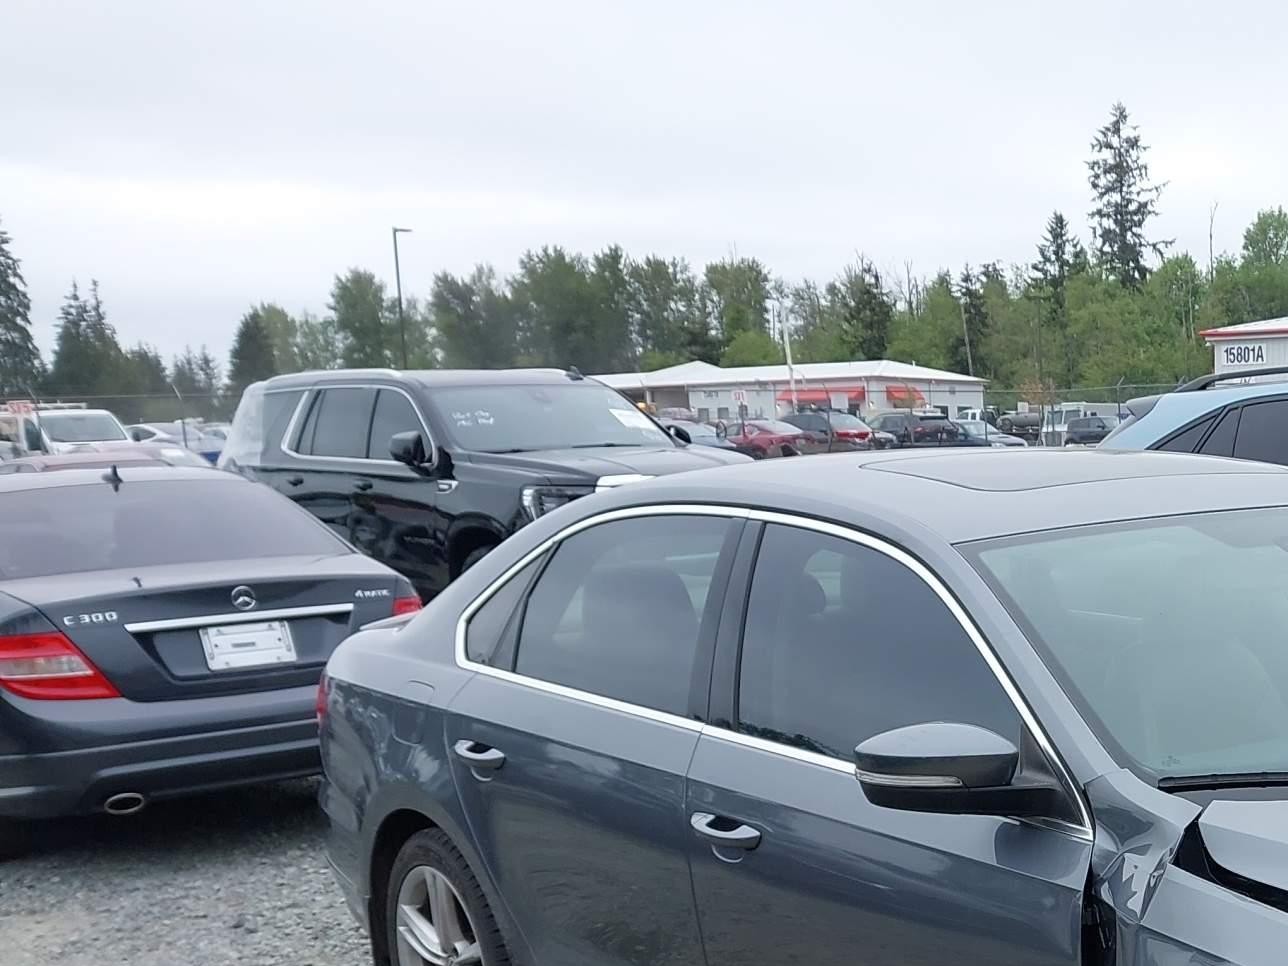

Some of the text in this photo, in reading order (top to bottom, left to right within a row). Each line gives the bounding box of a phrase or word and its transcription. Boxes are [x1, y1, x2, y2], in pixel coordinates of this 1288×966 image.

[1224, 345, 1265, 363] 15801A
[63, 611, 118, 626] C 300
